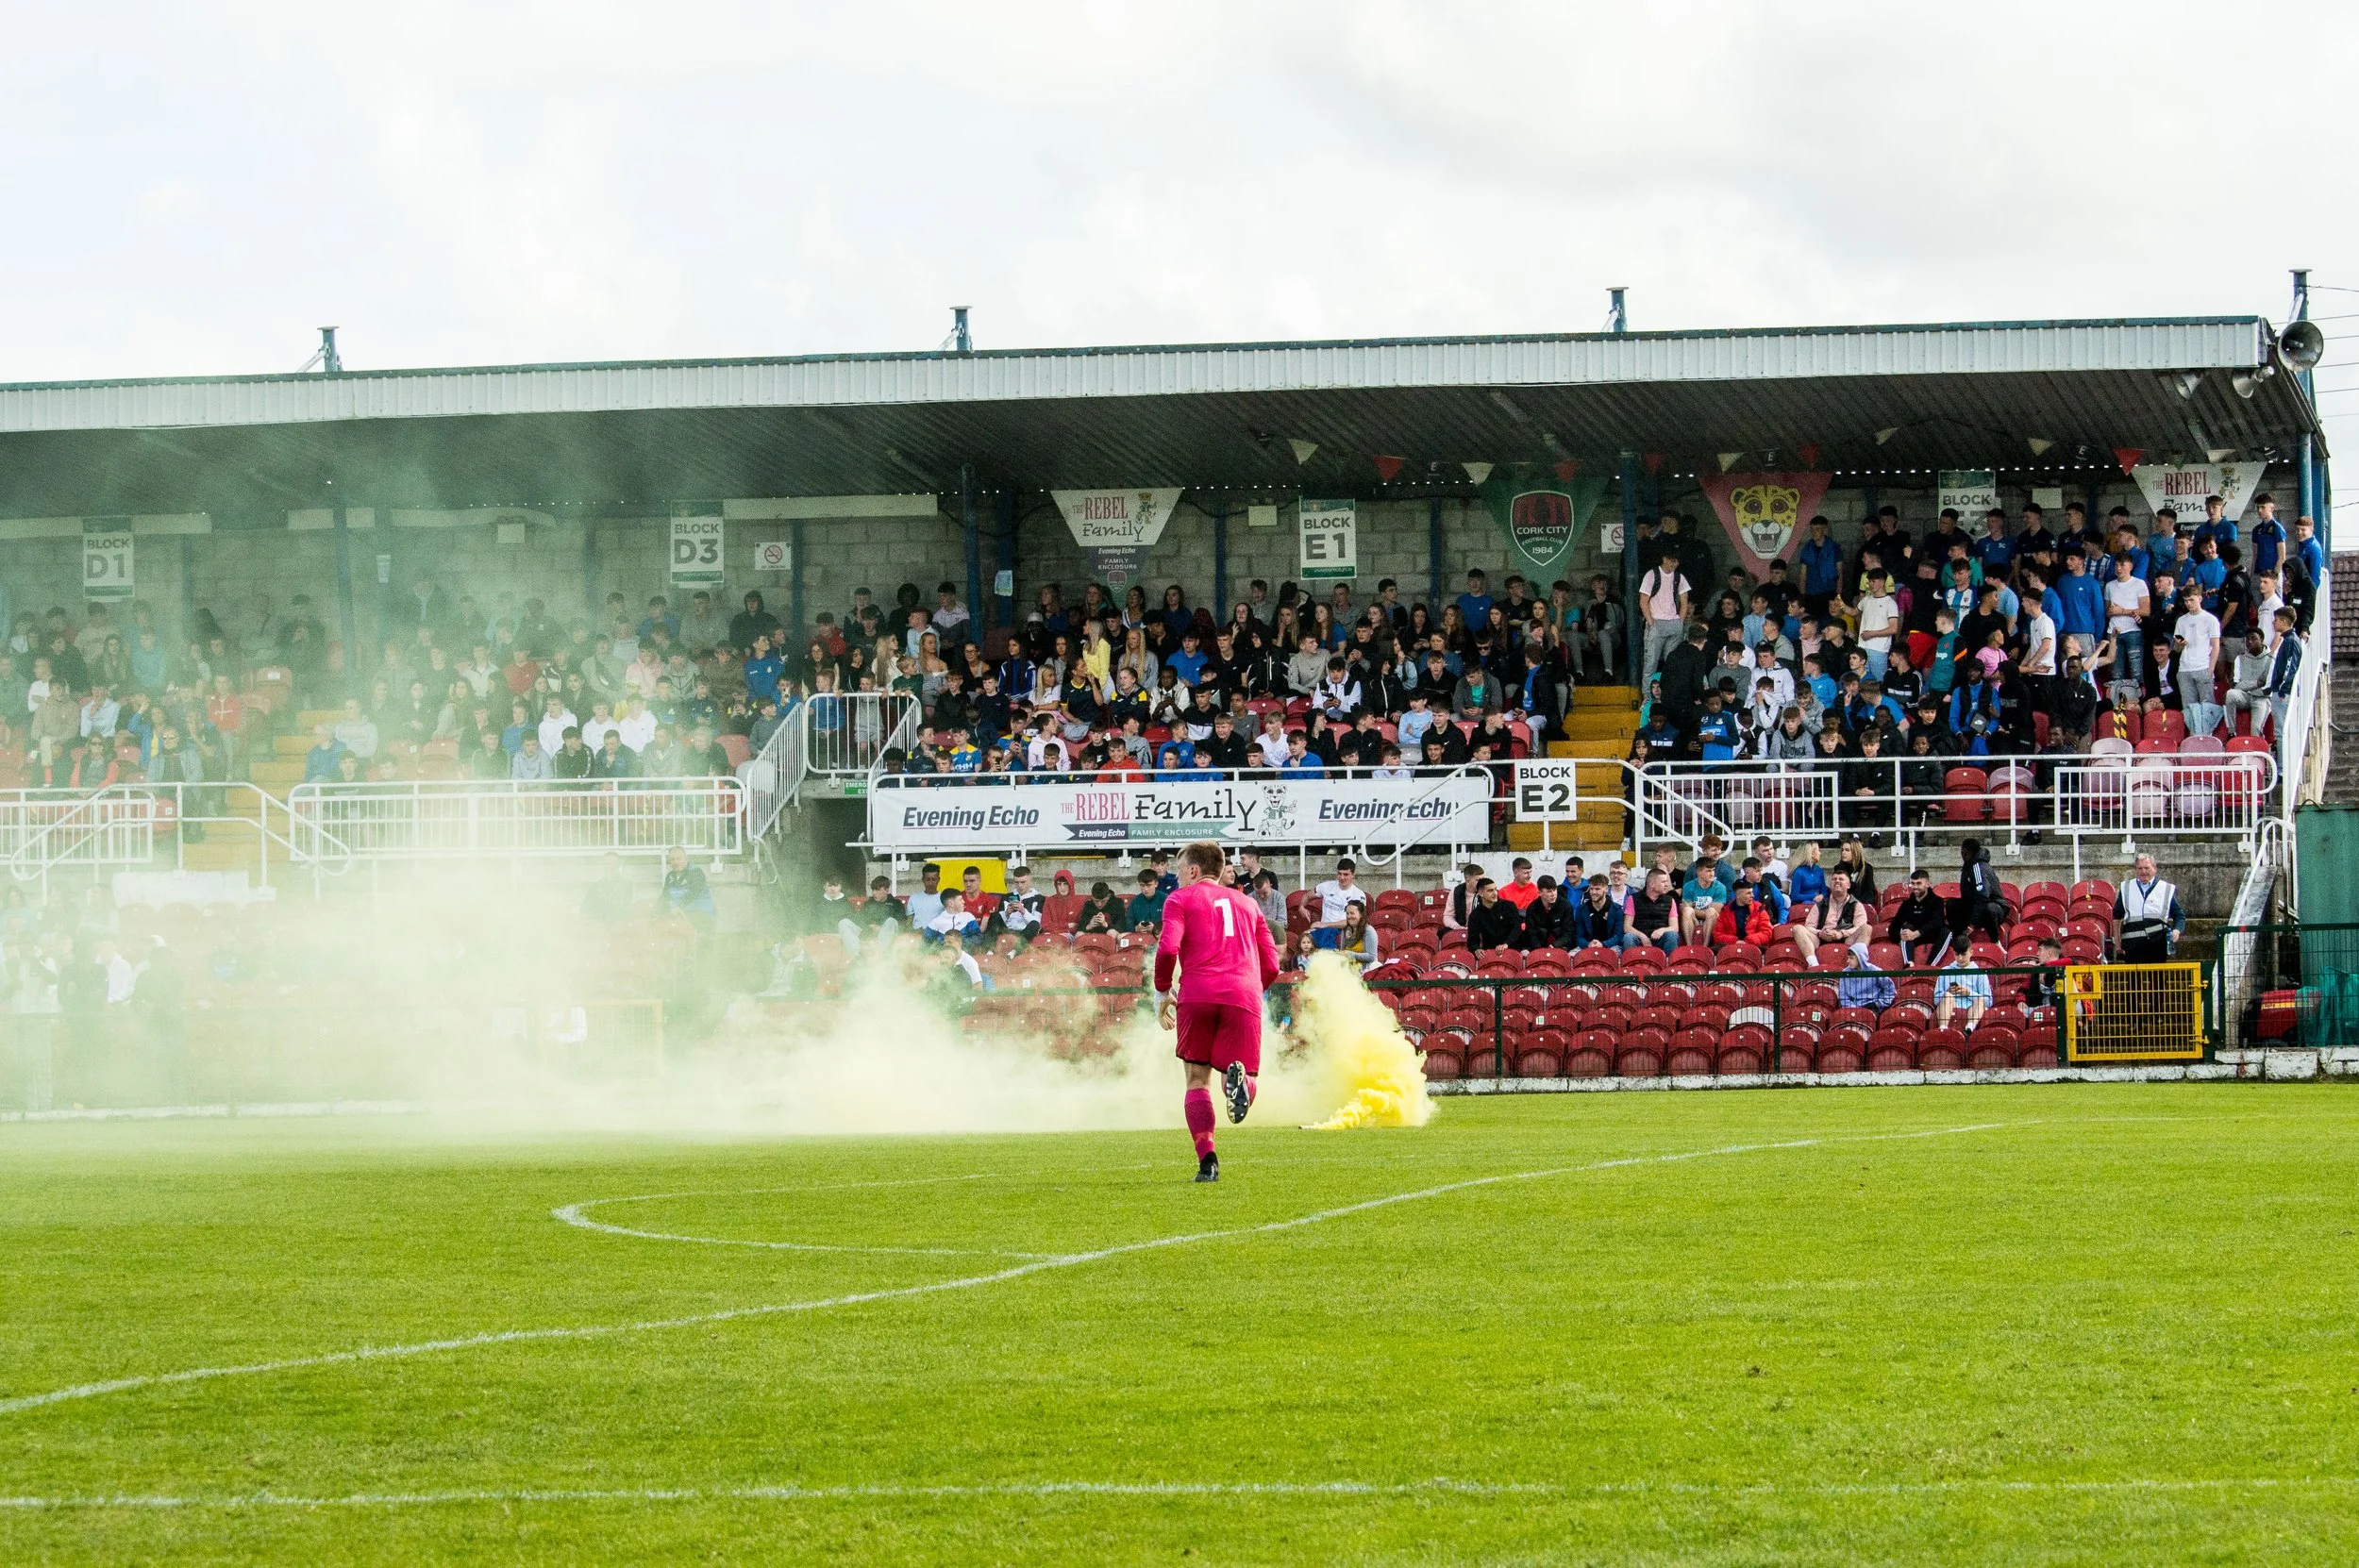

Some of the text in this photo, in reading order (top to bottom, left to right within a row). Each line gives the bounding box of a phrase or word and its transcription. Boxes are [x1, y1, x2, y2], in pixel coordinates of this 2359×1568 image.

[2165, 472, 2211, 495] REBEL
[1084, 496, 1129, 520] REBEL
[1943, 494, 1991, 505] BLOCK
[676, 524, 719, 534] BLOCK
[1304, 517, 1350, 529] BLOCK
[88, 539, 129, 549] BLOCK
[675, 539, 718, 564] D3
[1306, 533, 1346, 559] E1
[87, 555, 125, 579] D1
[1520, 767, 1571, 779] BLOCK
[1061, 802, 1075, 814] THE
[1076, 792, 1130, 821] REBEL
[1522, 784, 1571, 813] E2
[903, 805, 1040, 830] Evening Echo
[1079, 829, 1107, 839] Evening
[1213, 897, 1234, 937] 1
